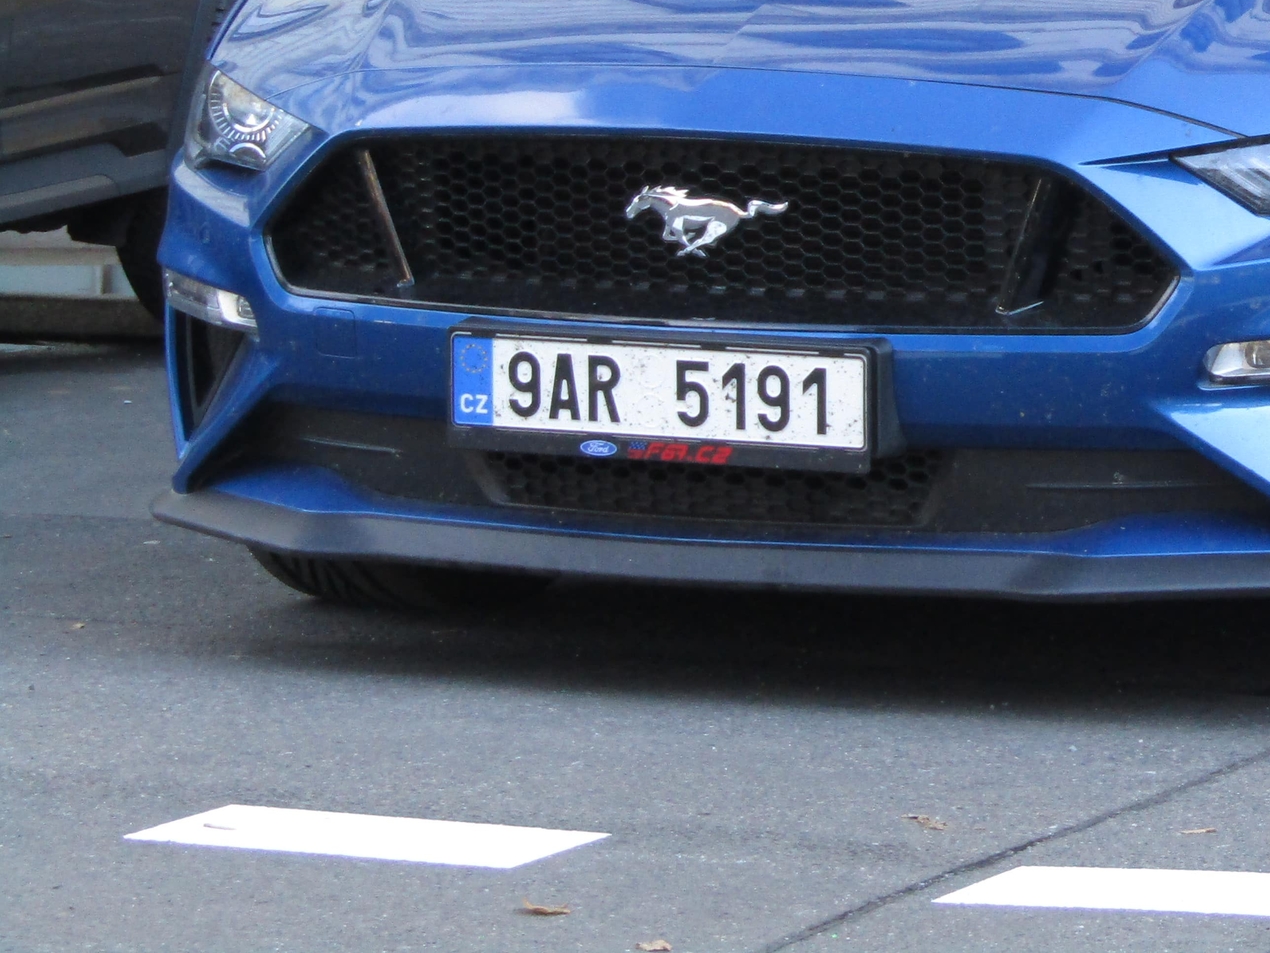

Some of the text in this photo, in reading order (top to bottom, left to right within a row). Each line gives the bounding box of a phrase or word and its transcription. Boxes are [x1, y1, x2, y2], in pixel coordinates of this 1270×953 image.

[460, 393, 488, 415] CZ
[508, 351, 829, 435] 9AR 5191
